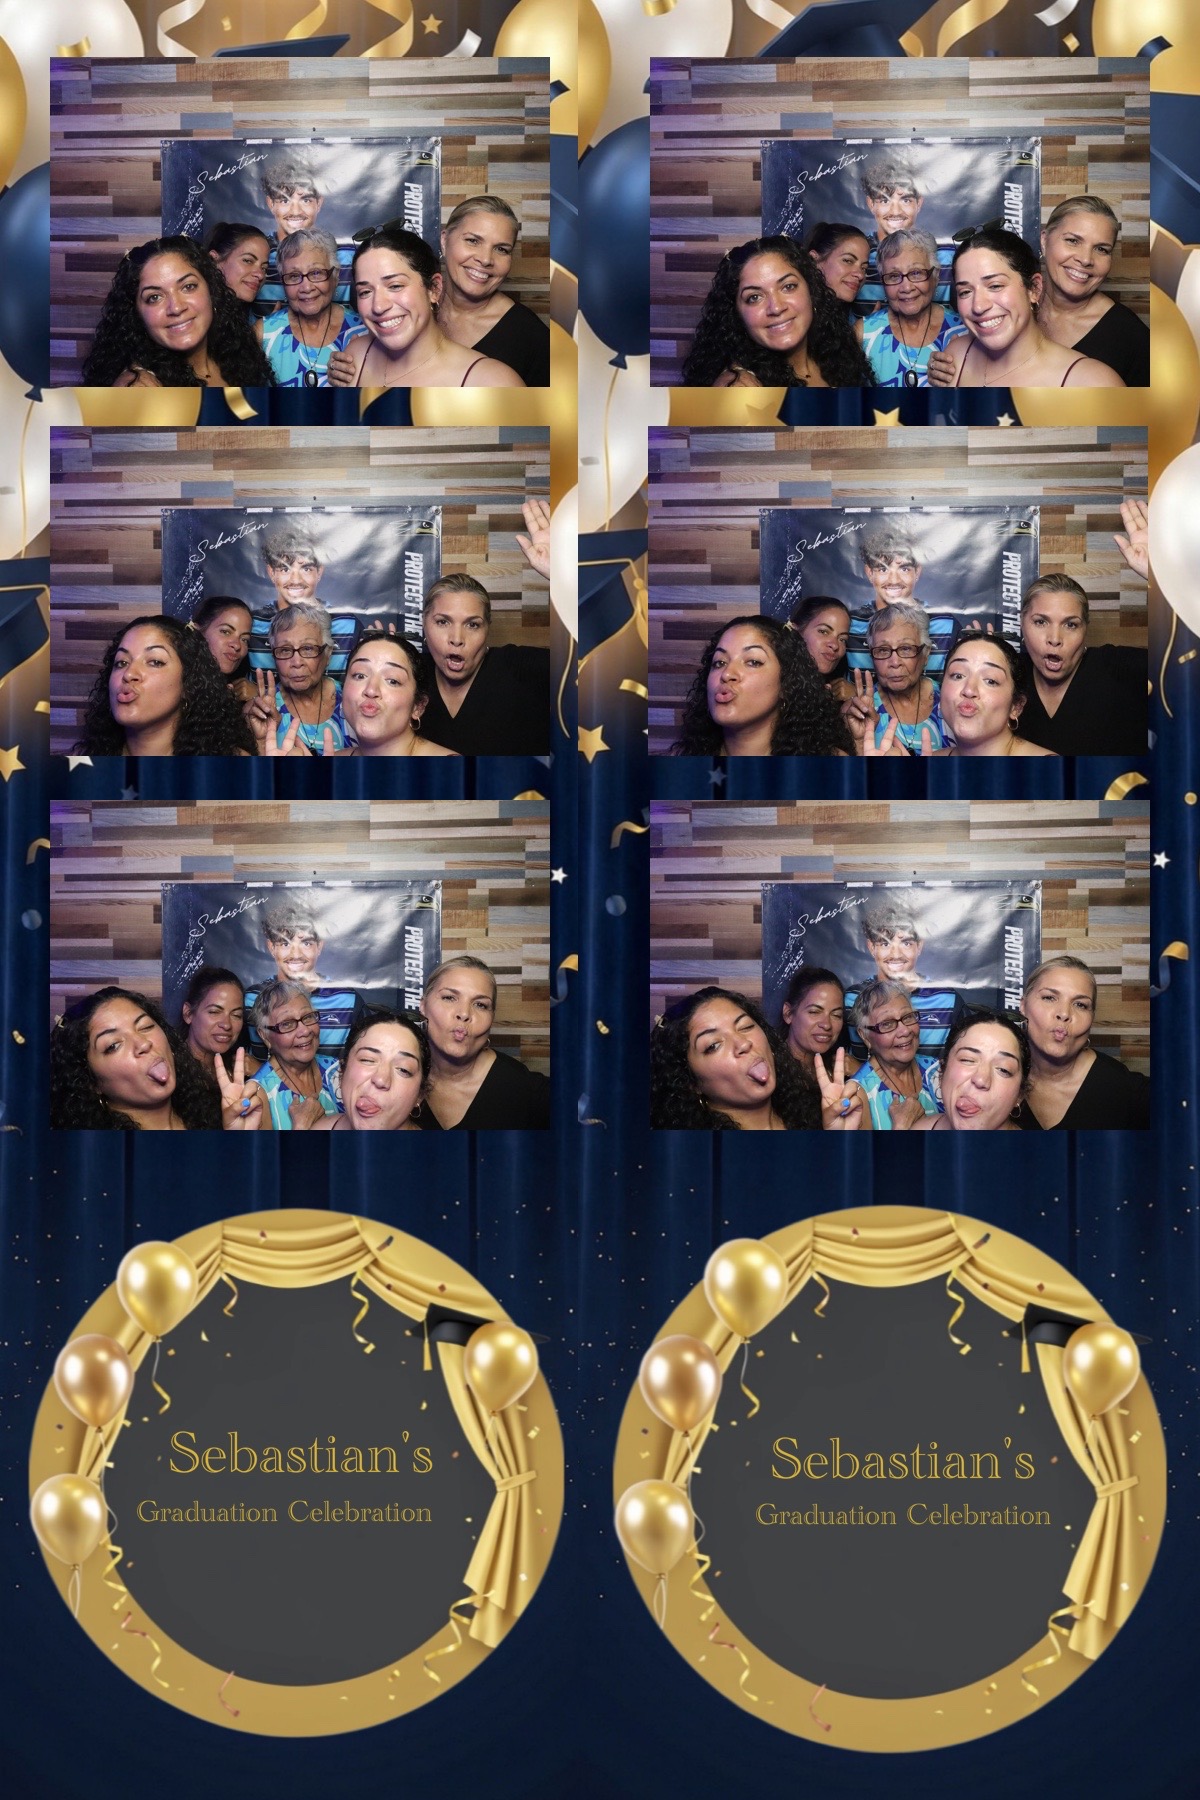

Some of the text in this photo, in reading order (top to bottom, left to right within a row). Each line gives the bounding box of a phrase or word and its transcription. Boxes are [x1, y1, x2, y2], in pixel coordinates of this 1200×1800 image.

[189, 152, 269, 194] Sebastian
[789, 152, 869, 194] Sebastian
[403, 182, 423, 239] PROTEC
[1003, 182, 1023, 239] PROTEC
[188, 521, 269, 563] Sebastian
[786, 521, 867, 563] Sebastian
[404, 551, 424, 611] PROTECT
[1002, 551, 1022, 611] PROTECT
[188, 895, 269, 937] Sebastian
[788, 895, 869, 937] Sebastian
[404, 925, 424, 986] PROTECT
[1004, 925, 1024, 986] PROTECT
